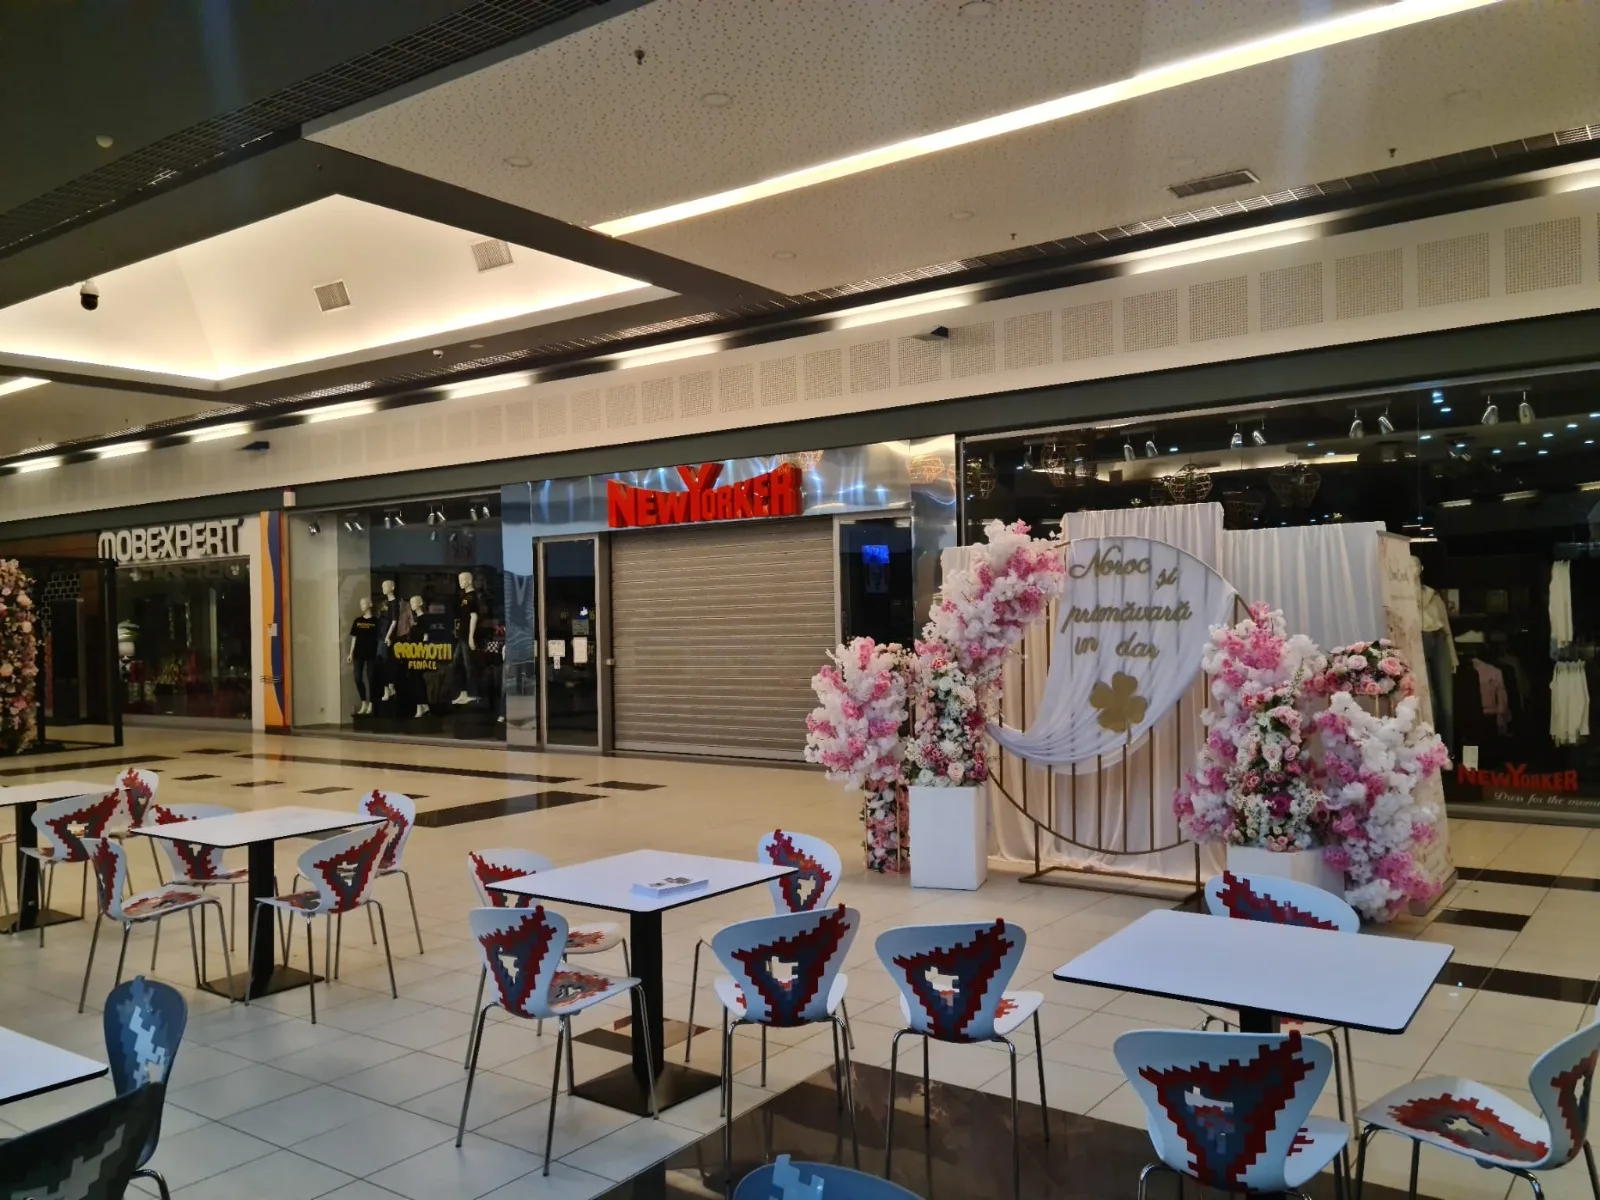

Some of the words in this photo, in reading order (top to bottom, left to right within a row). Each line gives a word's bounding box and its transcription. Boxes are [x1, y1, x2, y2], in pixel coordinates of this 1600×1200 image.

[97, 518, 240, 563] MOBEXPERT
[1069, 545, 1152, 579] Noroc
[1060, 600, 1193, 634] primăvară
[1115, 631, 1160, 660] dar
[408, 660, 438, 671] FINALE
[1494, 791, 1524, 803] Dress
[1527, 793, 1544, 806] for
[1547, 794, 1565, 806] the
